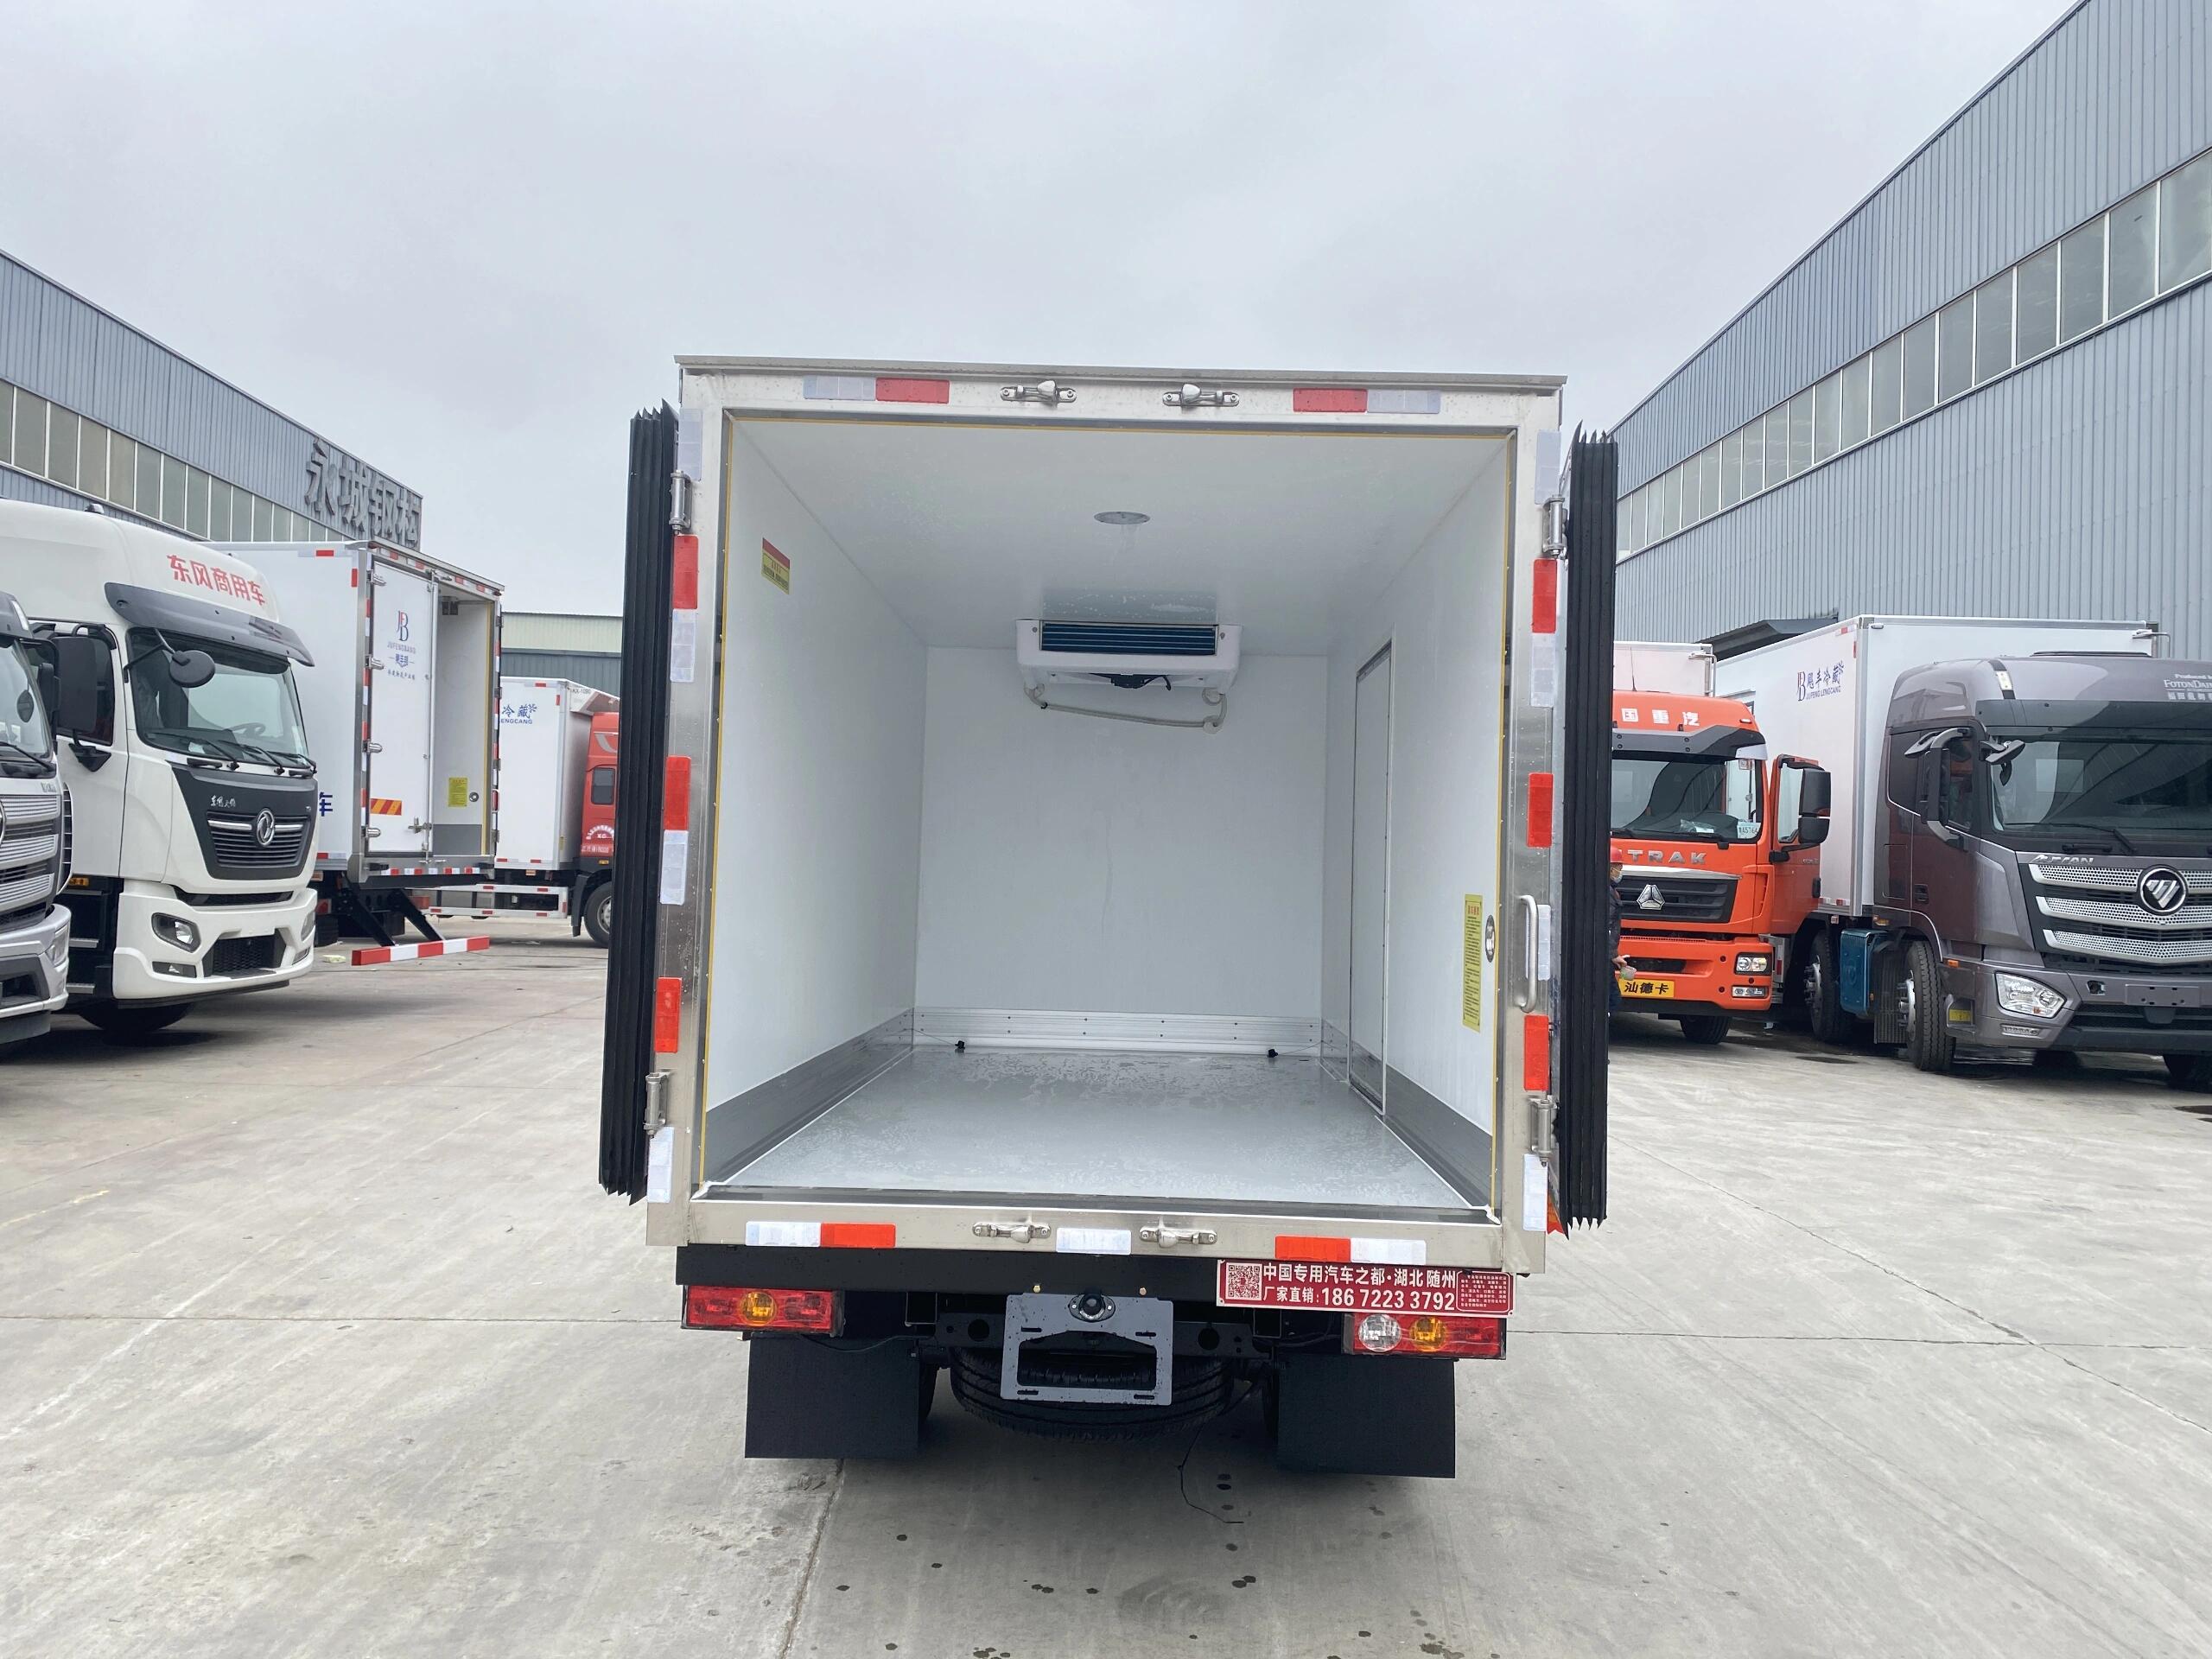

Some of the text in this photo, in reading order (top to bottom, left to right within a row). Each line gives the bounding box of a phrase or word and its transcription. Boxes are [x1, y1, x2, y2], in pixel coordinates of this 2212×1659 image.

[167, 554, 265, 606] 东风商用车
[1618, 849, 1707, 864] TRAK
[1624, 982, 1669, 995] 汕德卡
[1321, 1287, 1354, 1306] 186
[1360, 1288, 1404, 1308] 7223
[1410, 1290, 1455, 1311] 3792
